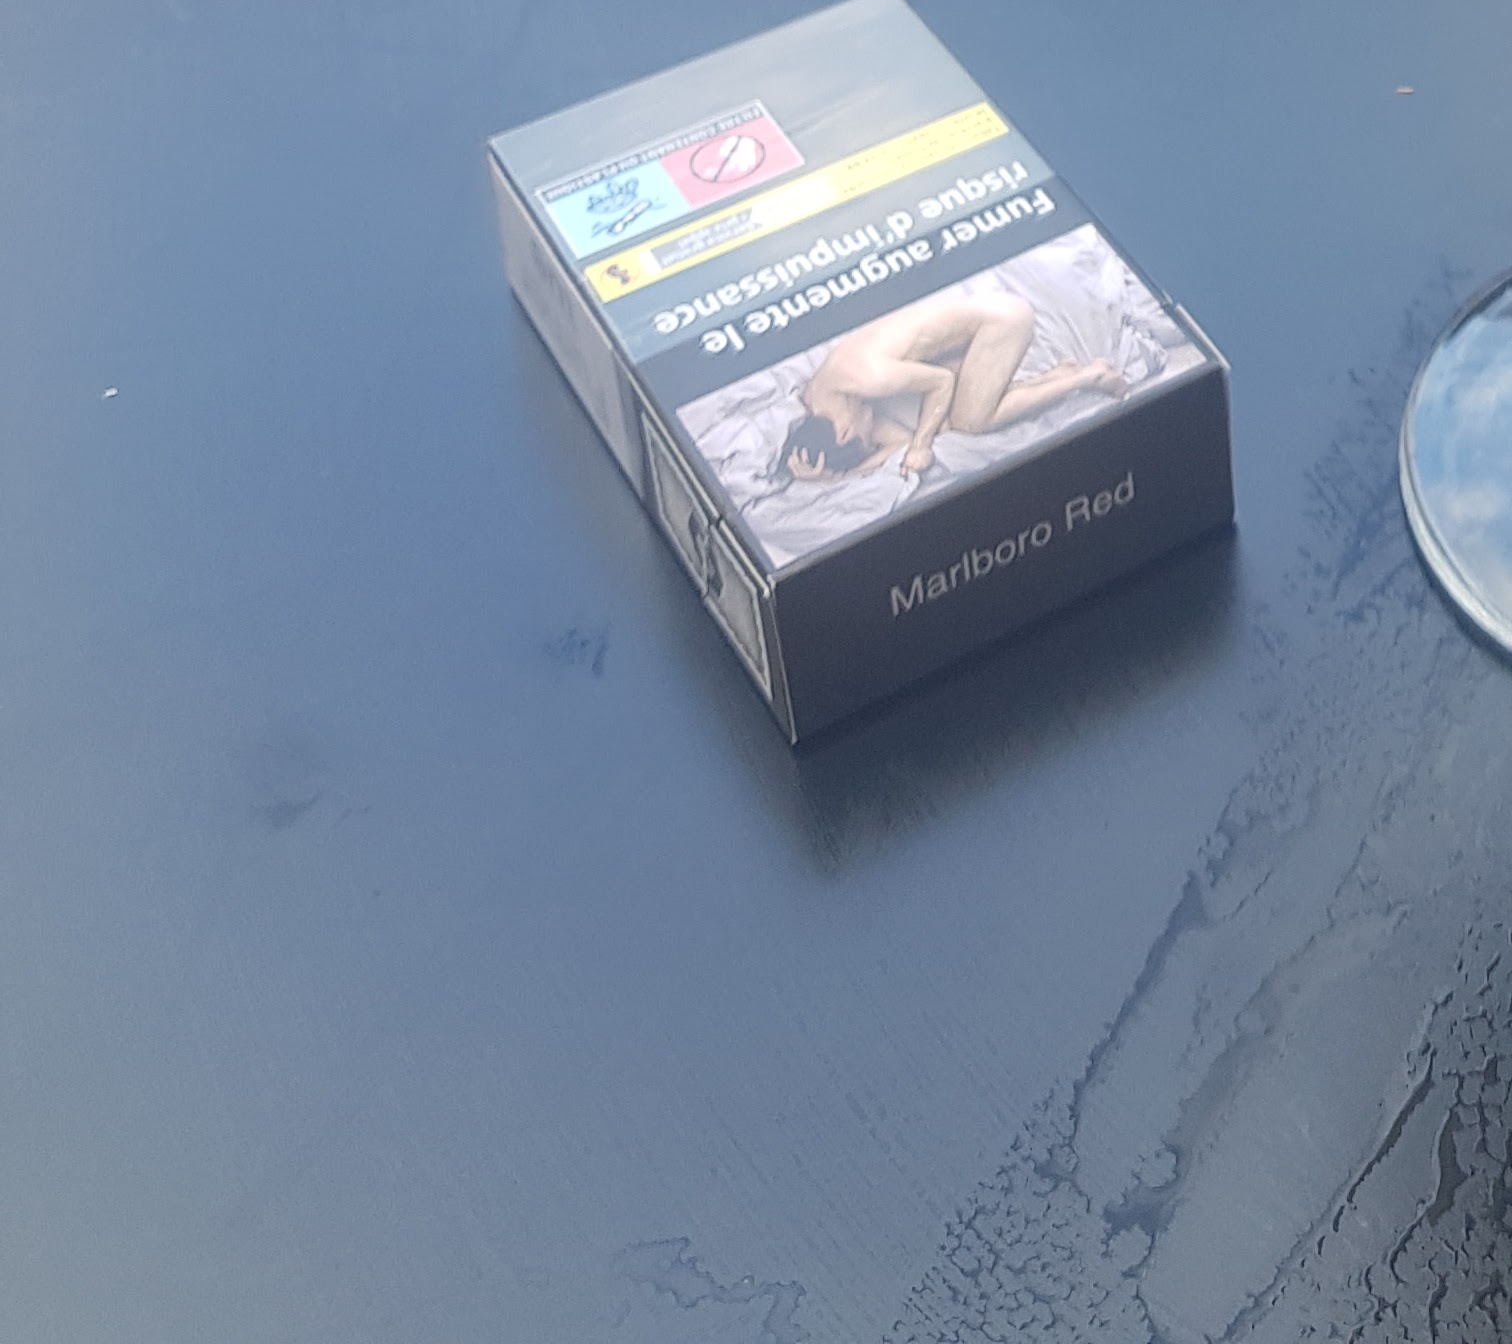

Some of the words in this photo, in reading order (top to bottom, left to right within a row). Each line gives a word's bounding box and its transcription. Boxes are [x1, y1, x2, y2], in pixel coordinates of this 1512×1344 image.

[918, 160, 1029, 218] risque
[940, 188, 1056, 254] Fumer
[652, 211, 914, 334] d'impuissance
[743, 235, 934, 335] augmente
[700, 329, 745, 354] le
[890, 521, 1052, 616] Marlboro
[1065, 472, 1135, 531] Red
